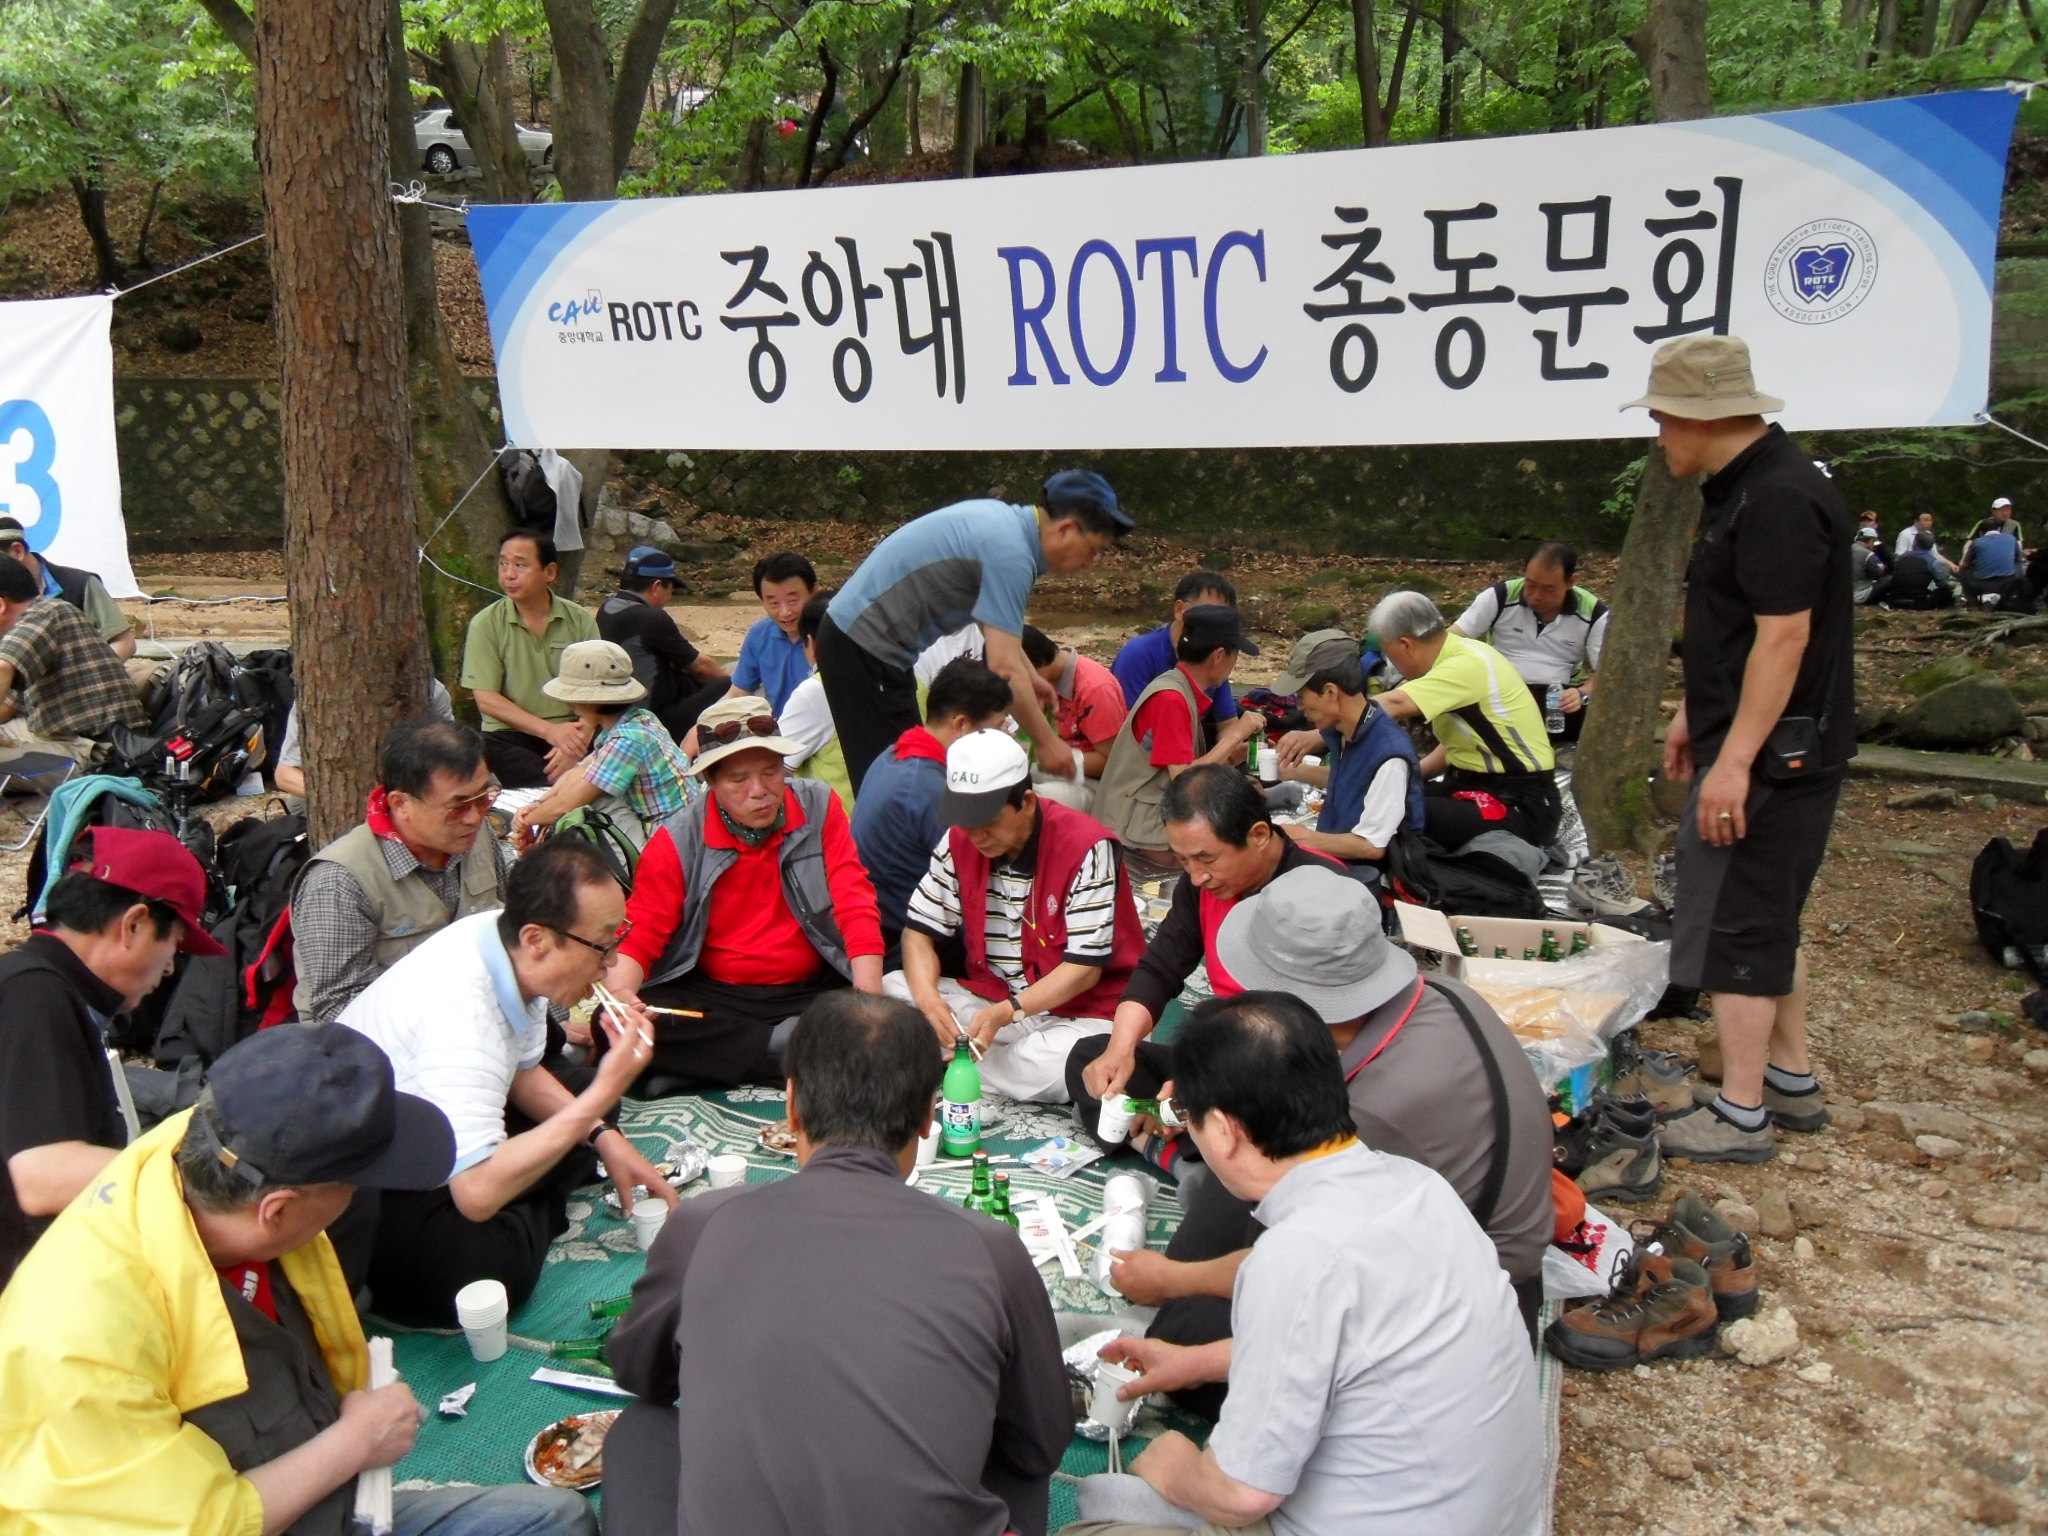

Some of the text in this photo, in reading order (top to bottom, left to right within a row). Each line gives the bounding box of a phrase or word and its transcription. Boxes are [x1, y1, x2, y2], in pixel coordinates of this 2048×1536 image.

[1812, 222, 1851, 233] Officers
[1778, 229, 1809, 255] Reserve
[1853, 229, 1874, 262] Training
[1768, 257, 1779, 281] KOREA
[1803, 275, 1837, 286] ROTC
[1860, 265, 1875, 289] Corps
[719, 176, 1744, 405] 중앙대 ROTC 총동문회
[548, 295, 603, 326] CAU
[607, 300, 703, 342] ROTC
[1783, 302, 1853, 321] ASSOCIATION
[557, 330, 604, 344] 중앙대학교
[0, 399, 62, 553] 3
[951, 771, 980, 784] CAU
